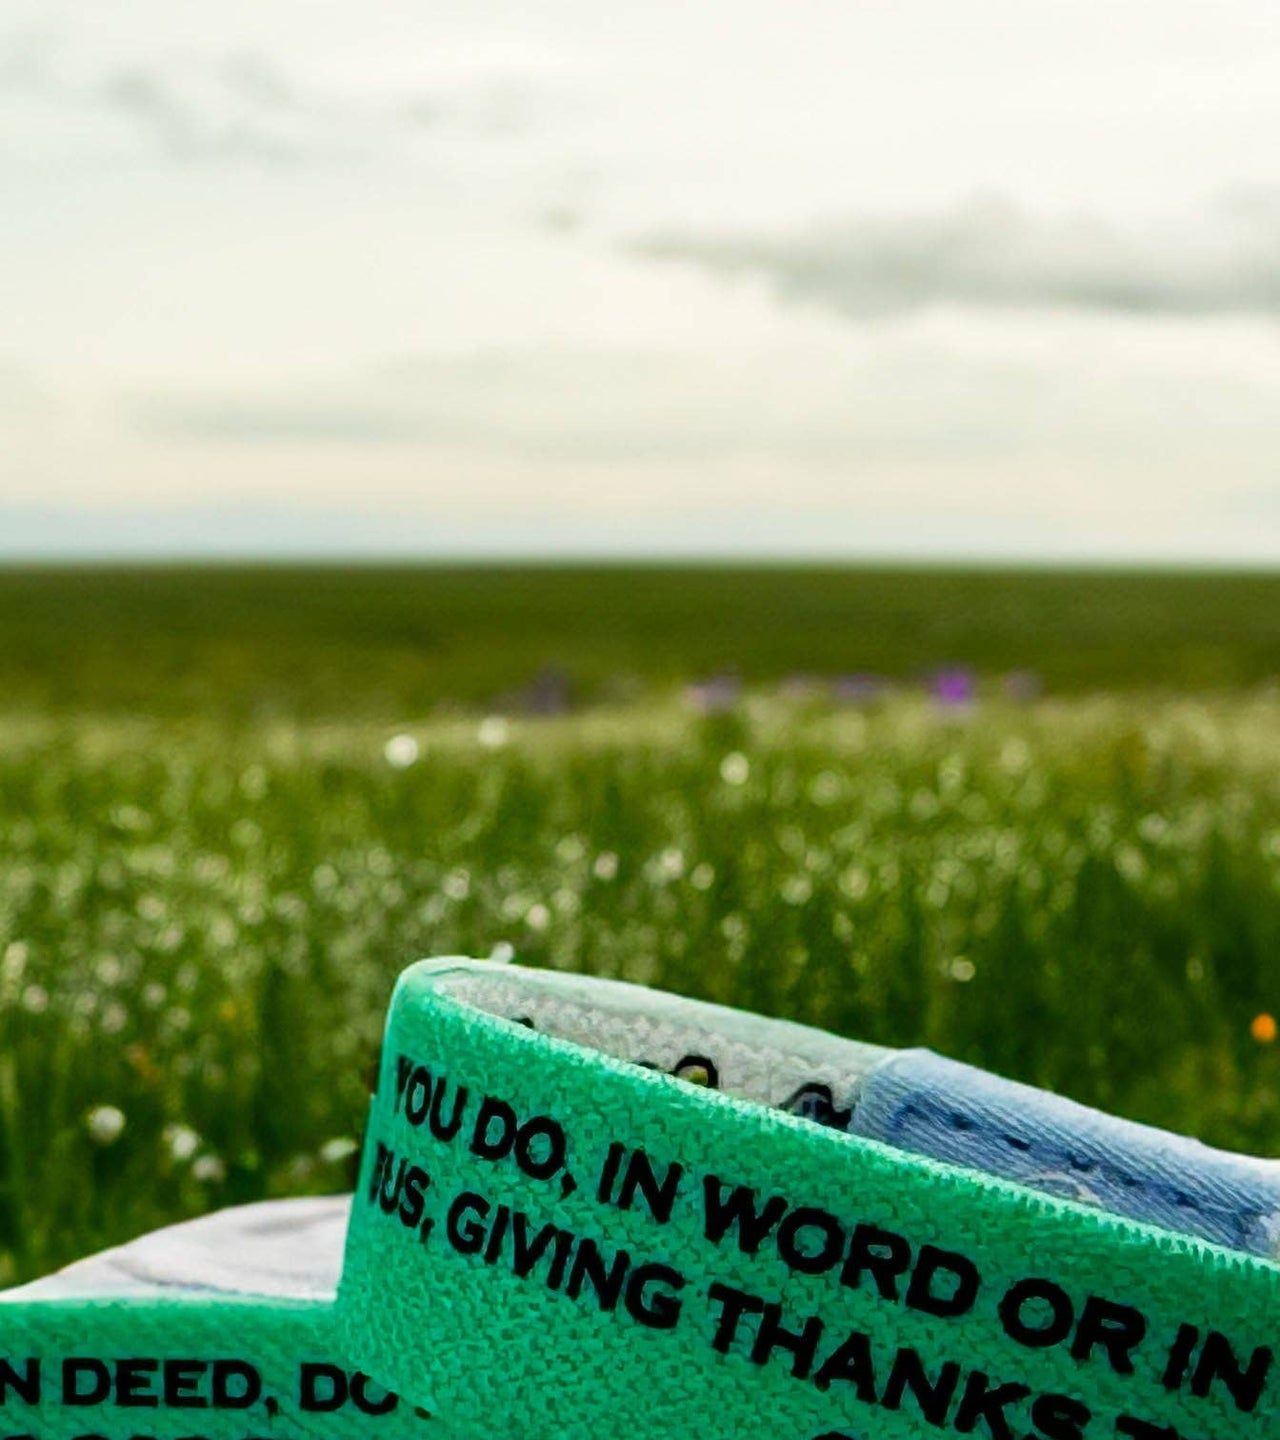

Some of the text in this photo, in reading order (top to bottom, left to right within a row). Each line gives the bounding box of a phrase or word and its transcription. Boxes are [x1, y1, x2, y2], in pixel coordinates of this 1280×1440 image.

[396, 1054, 469, 1142] YOU
[469, 1095, 578, 1200] DO,
[596, 1141, 684, 1225] IN
[702, 1173, 984, 1320] WORD
[996, 1277, 1149, 1378] OR
[1161, 1322, 1276, 1413] IN
[447, 1191, 686, 1330] GIVING
[61, 1357, 280, 1419] DEED,
[298, 1362, 400, 1417] DO
